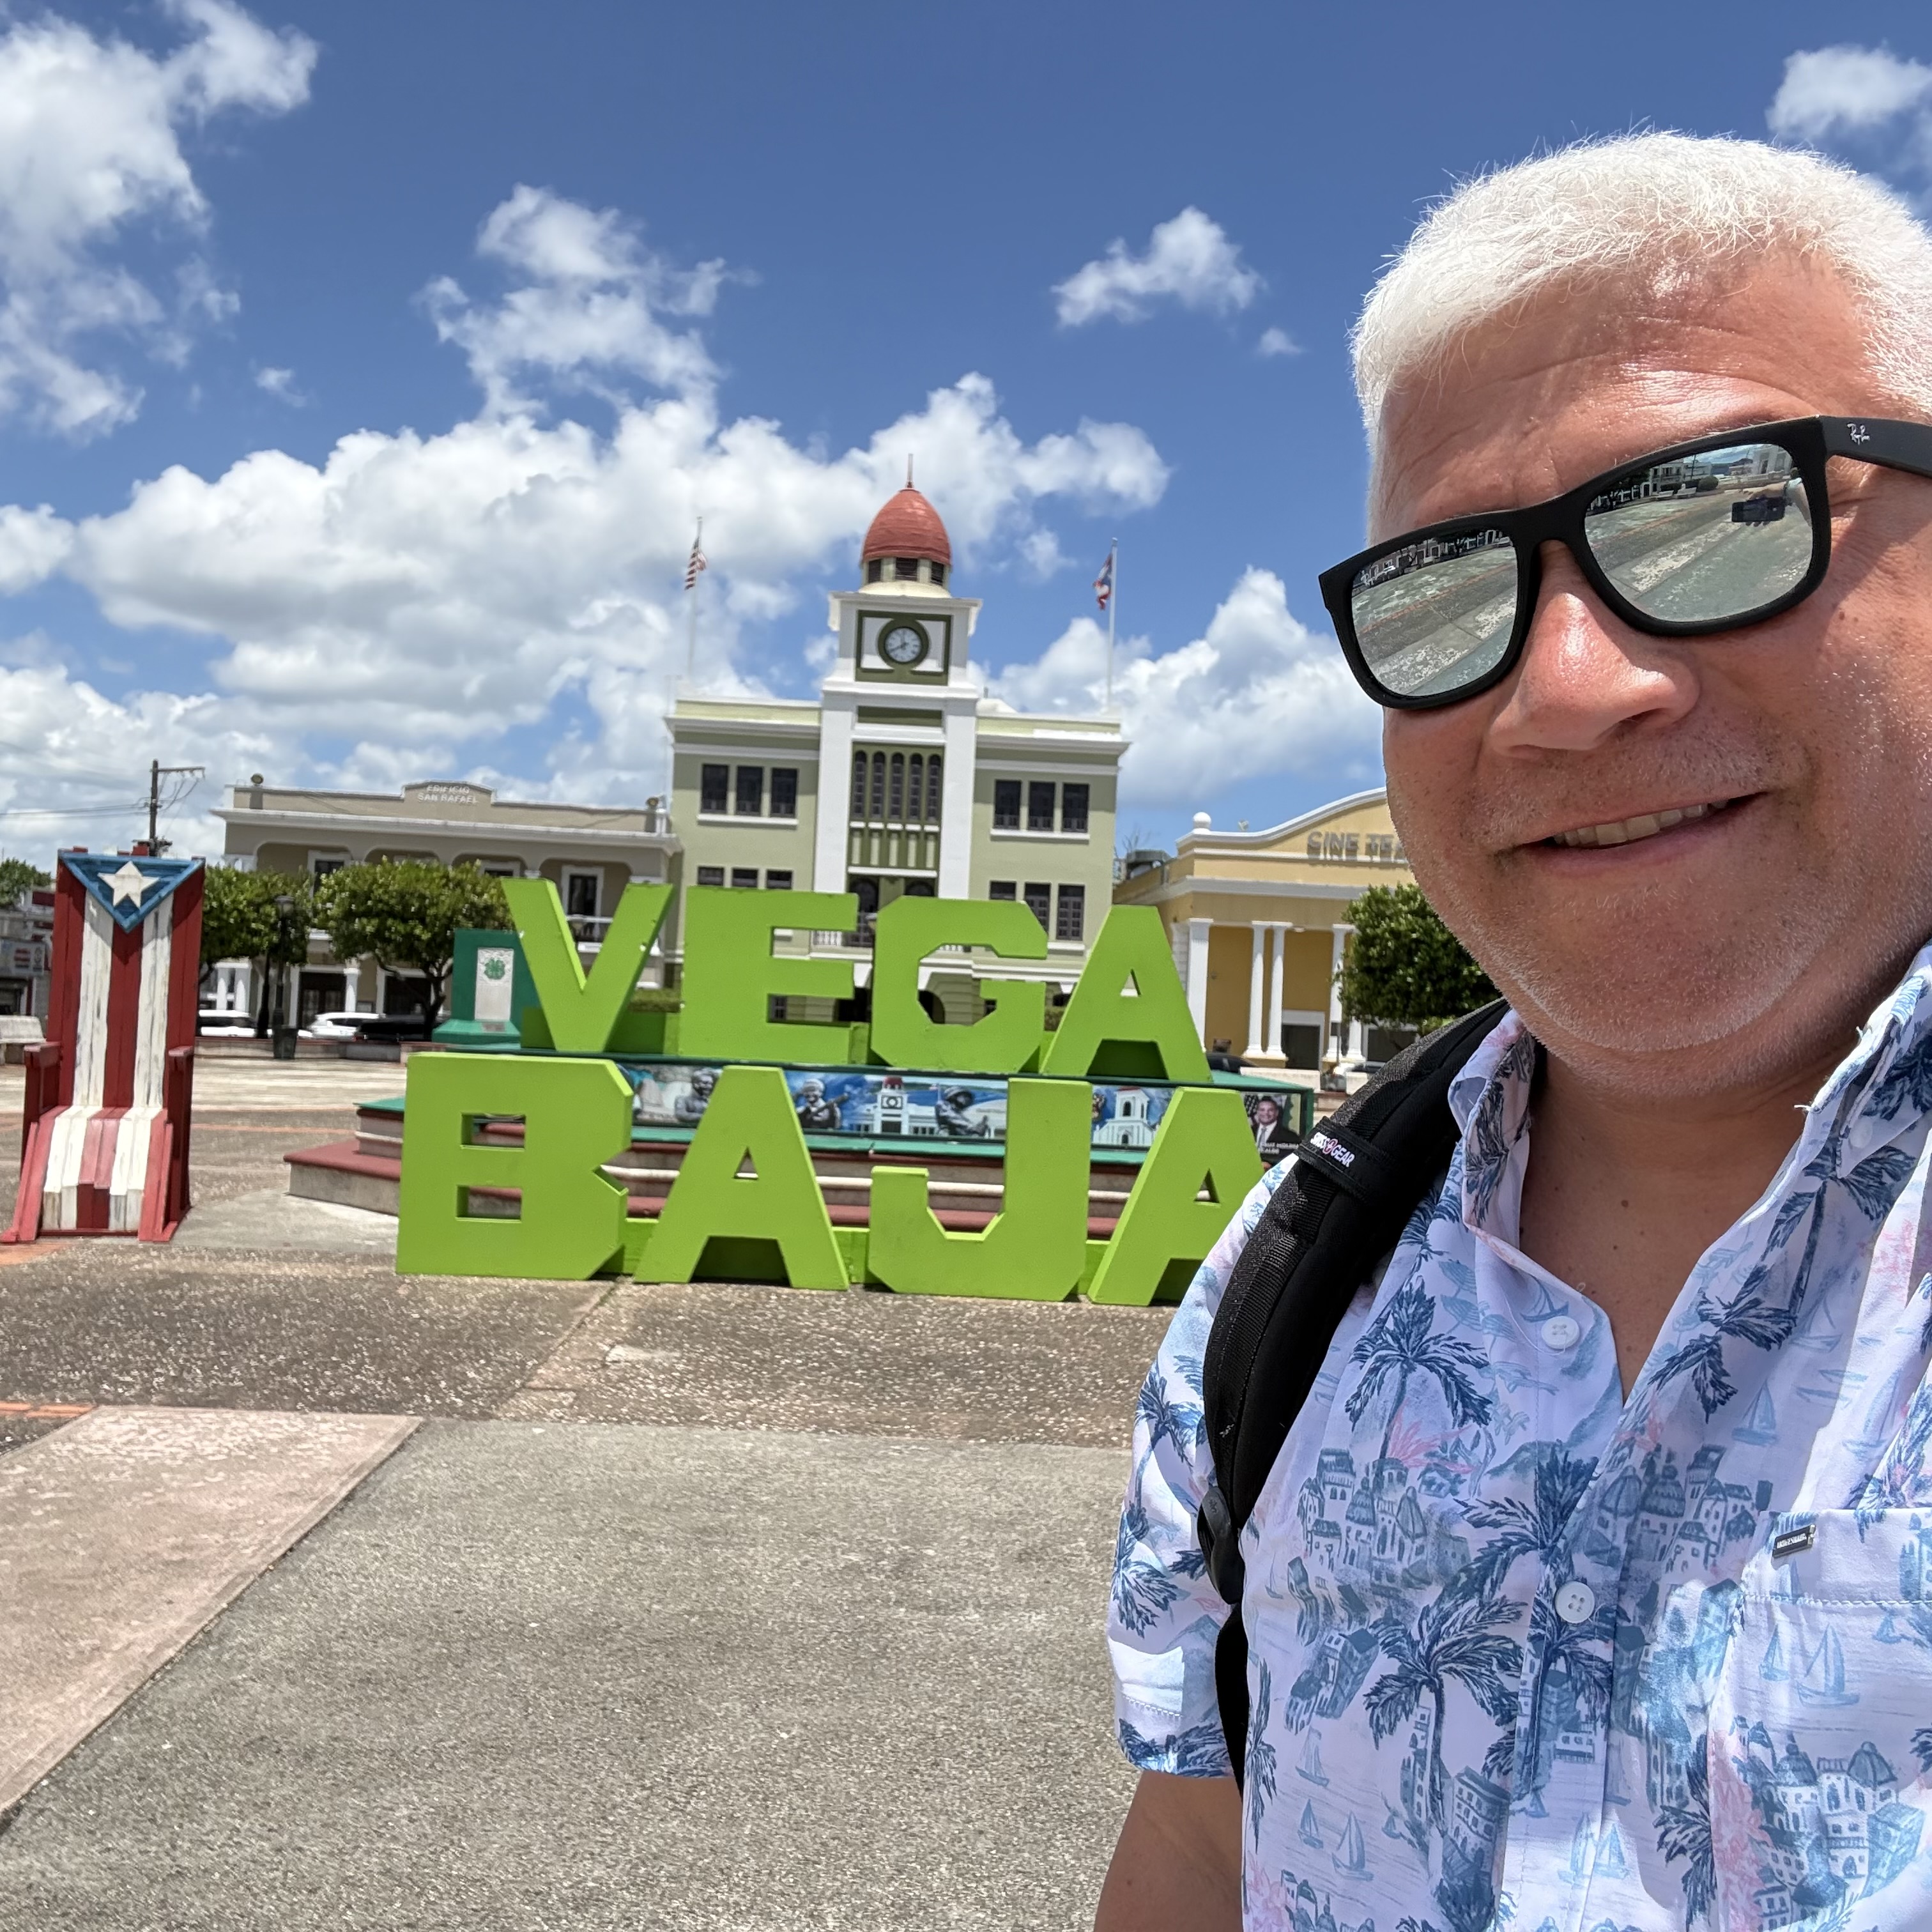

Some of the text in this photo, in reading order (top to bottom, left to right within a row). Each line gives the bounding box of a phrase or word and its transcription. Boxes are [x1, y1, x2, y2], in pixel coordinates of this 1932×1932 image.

[417, 793, 478, 804] SAN RAFAEL
[426, 785, 470, 795] EDIFICIO
[1307, 831, 1360, 851] CINE
[500, 878, 1214, 1083] VEGA
[396, 1052, 1264, 1306] BAJA
